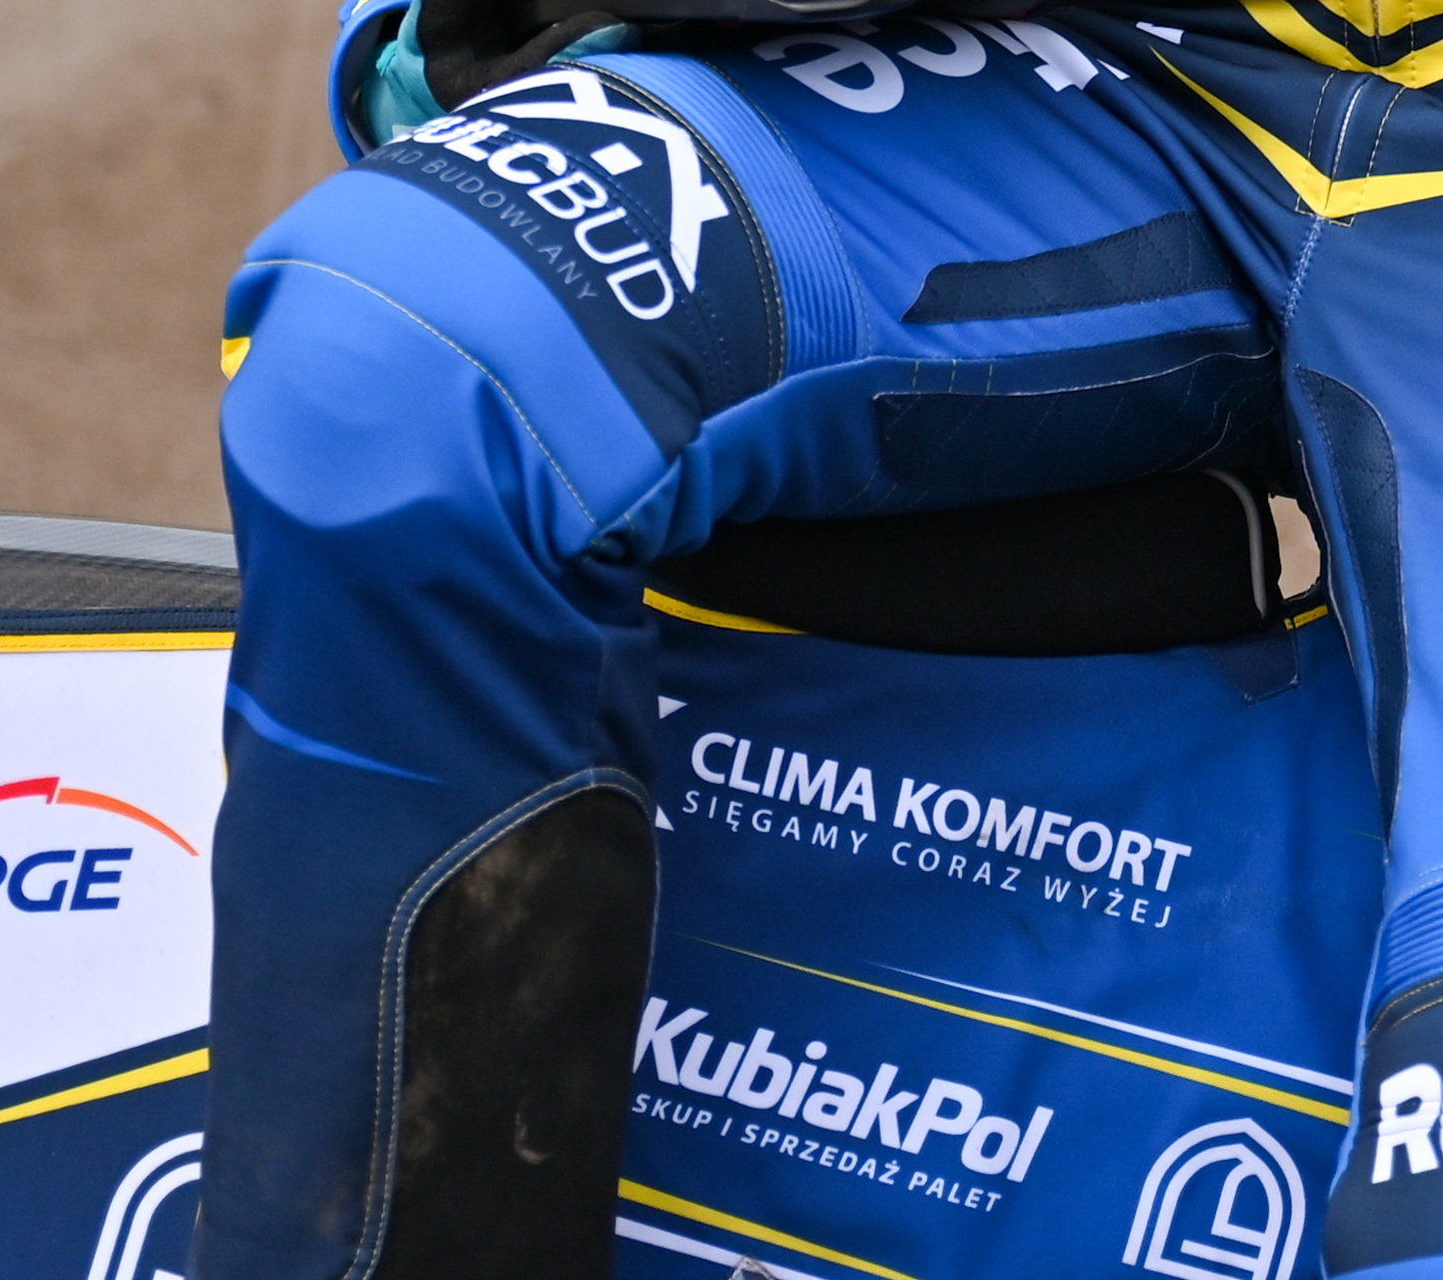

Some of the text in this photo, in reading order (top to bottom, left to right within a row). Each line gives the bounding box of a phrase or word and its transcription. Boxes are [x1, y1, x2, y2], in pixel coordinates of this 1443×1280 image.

[421, 158, 598, 300] BUDOWLANY
[682, 788, 1174, 929] SIĘGAMY CORAZ WYŻEJ
[690, 732, 1192, 893] CLIMA KOMFORT
[631, 1093, 1003, 1213] SKUP I SPRZEDAŻ PALET
[633, 996, 1054, 1183] KubiakPol
